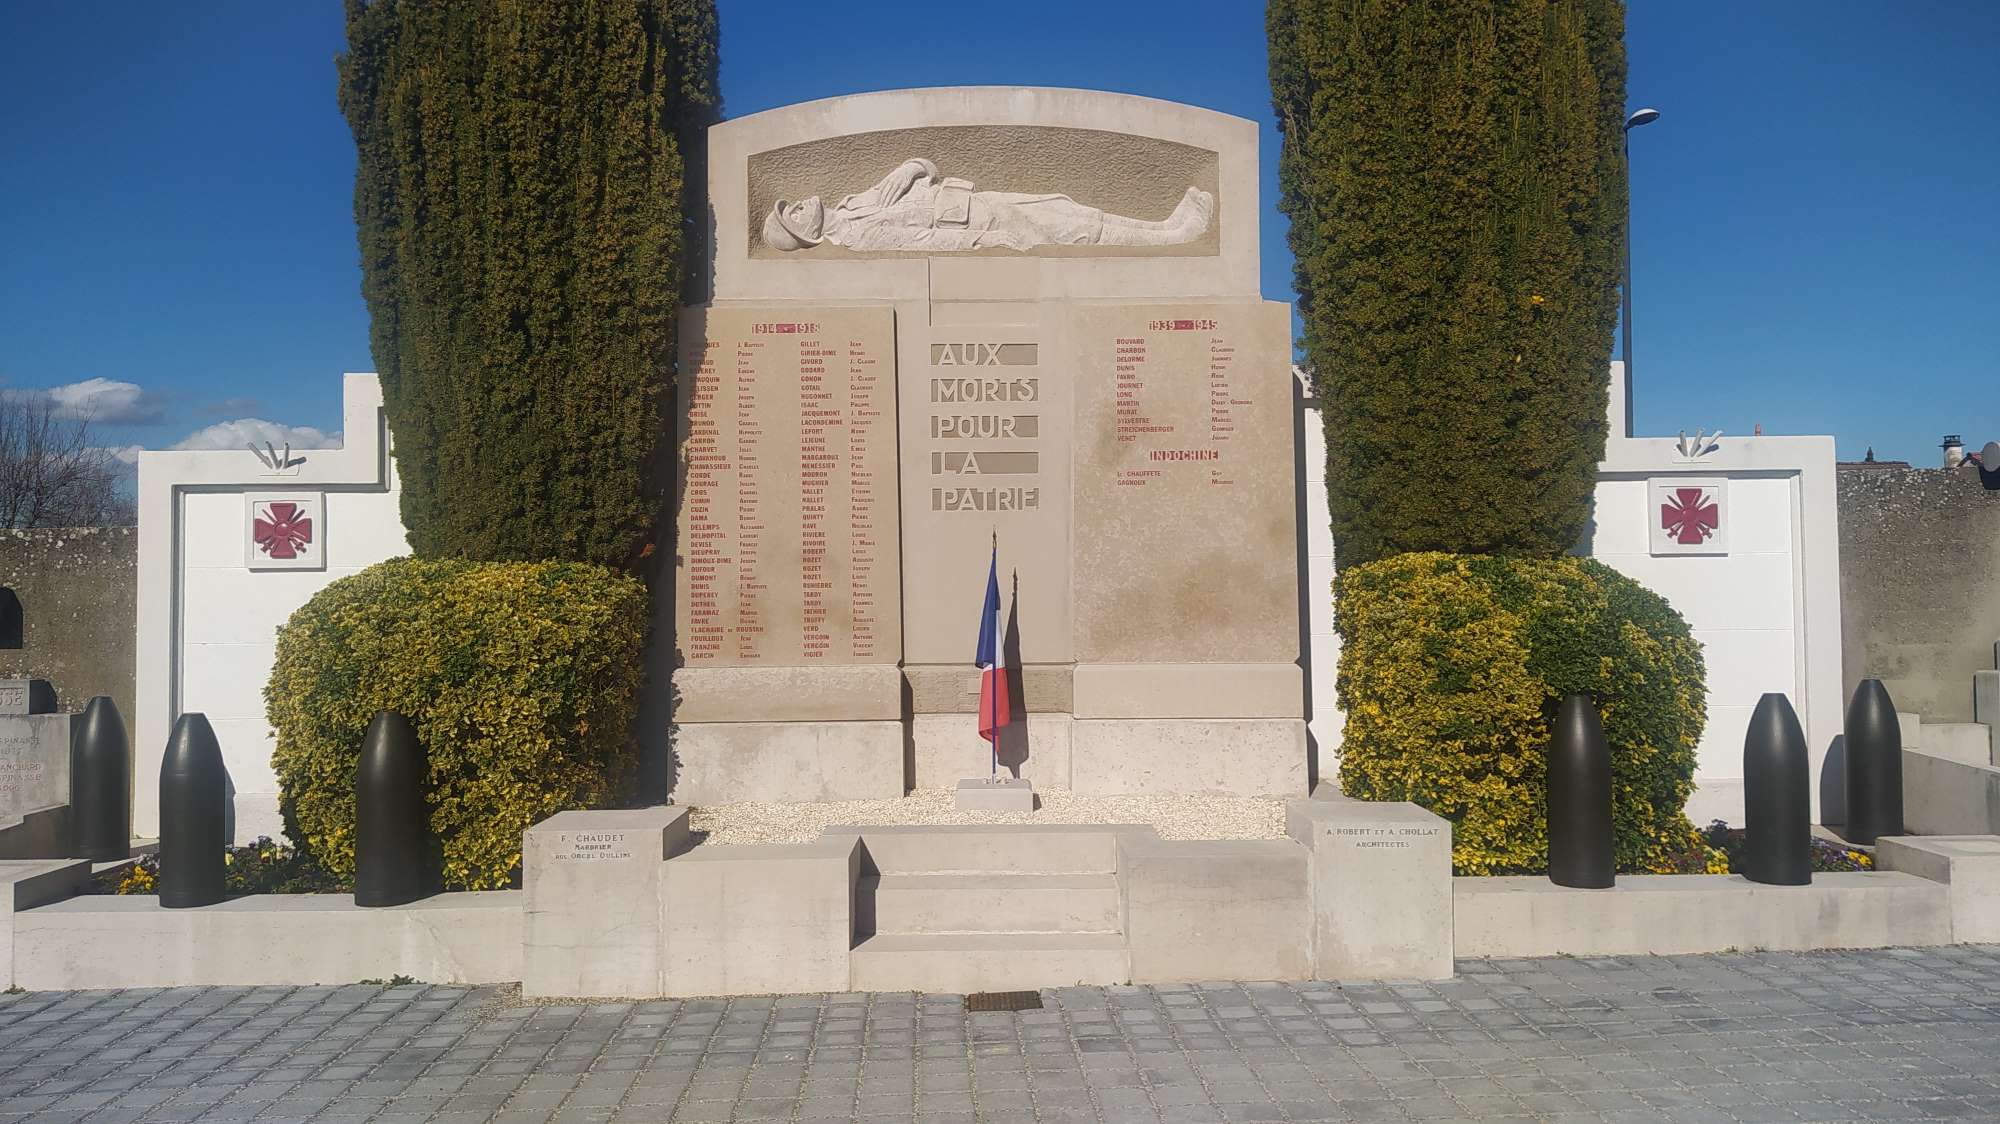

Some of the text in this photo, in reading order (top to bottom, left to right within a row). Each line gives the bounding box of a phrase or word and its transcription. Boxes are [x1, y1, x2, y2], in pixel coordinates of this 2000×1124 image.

[937, 343, 1002, 366] AUX
[937, 378, 1035, 402] MORTS
[937, 415, 1018, 439] POUR
[940, 450, 982, 475] LA
[1150, 450, 1219, 461] INDOCHINE
[940, 487, 1040, 511] PATRIE
[576, 834, 625, 843] CHAUDET
[1336, 828, 1371, 836] ROBERT
[1399, 828, 1441, 836] CHOLLAT
